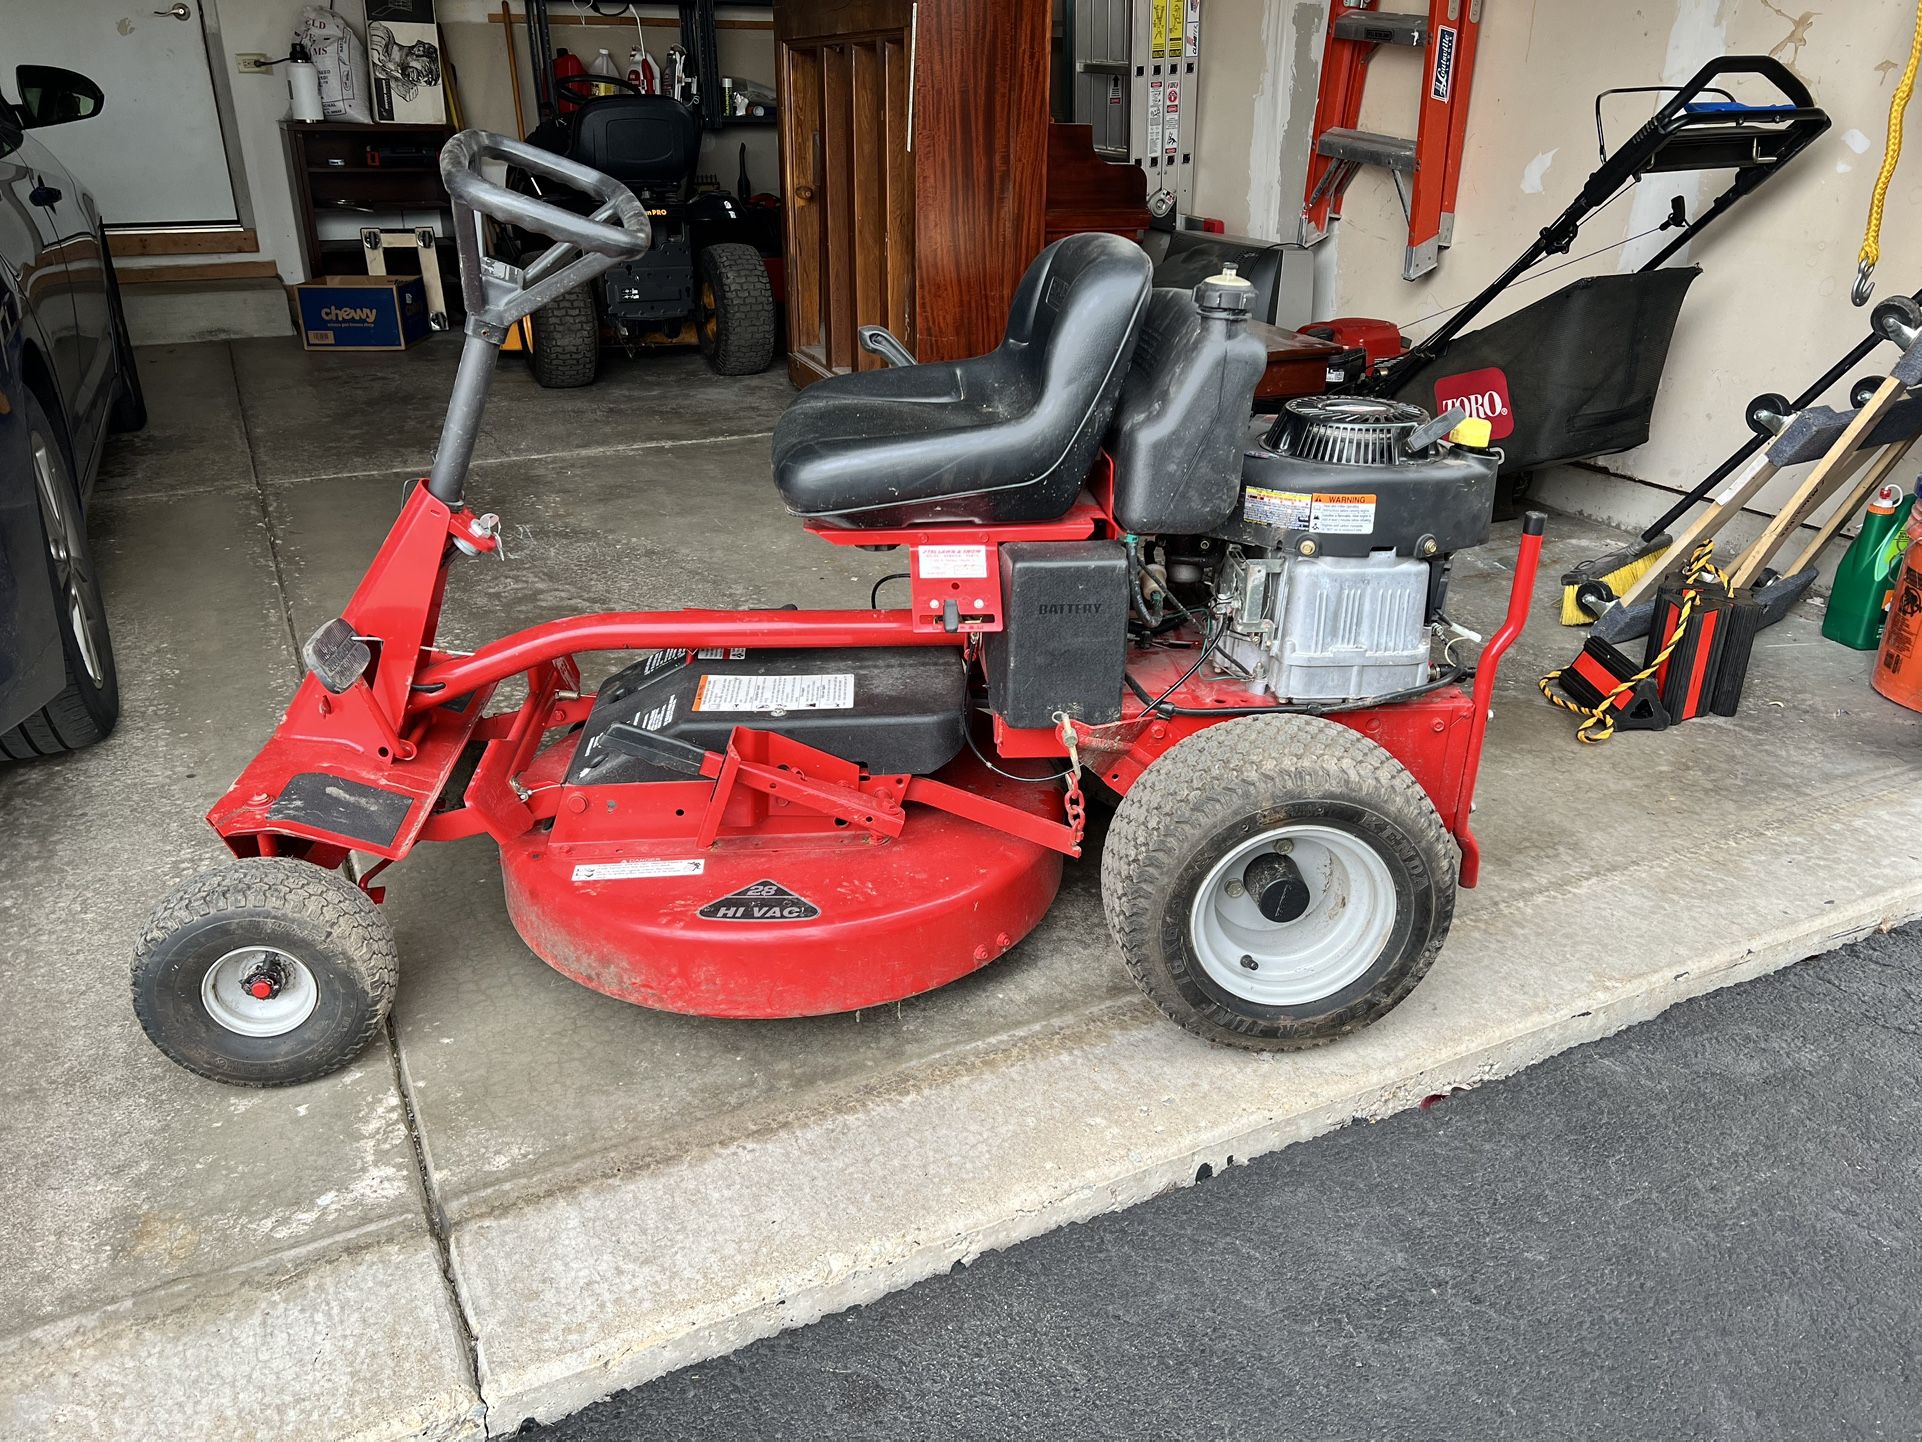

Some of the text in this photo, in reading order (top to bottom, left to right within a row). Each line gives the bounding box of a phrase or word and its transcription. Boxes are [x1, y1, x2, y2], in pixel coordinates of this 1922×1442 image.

[321, 305, 377, 323] chewy
[1328, 495, 1367, 504] WARNING
[1039, 602, 1102, 615] BATTERY
[1360, 815, 1430, 894] KENDA
[747, 885, 777, 896] 28
[717, 906, 800, 918] HI VAC
